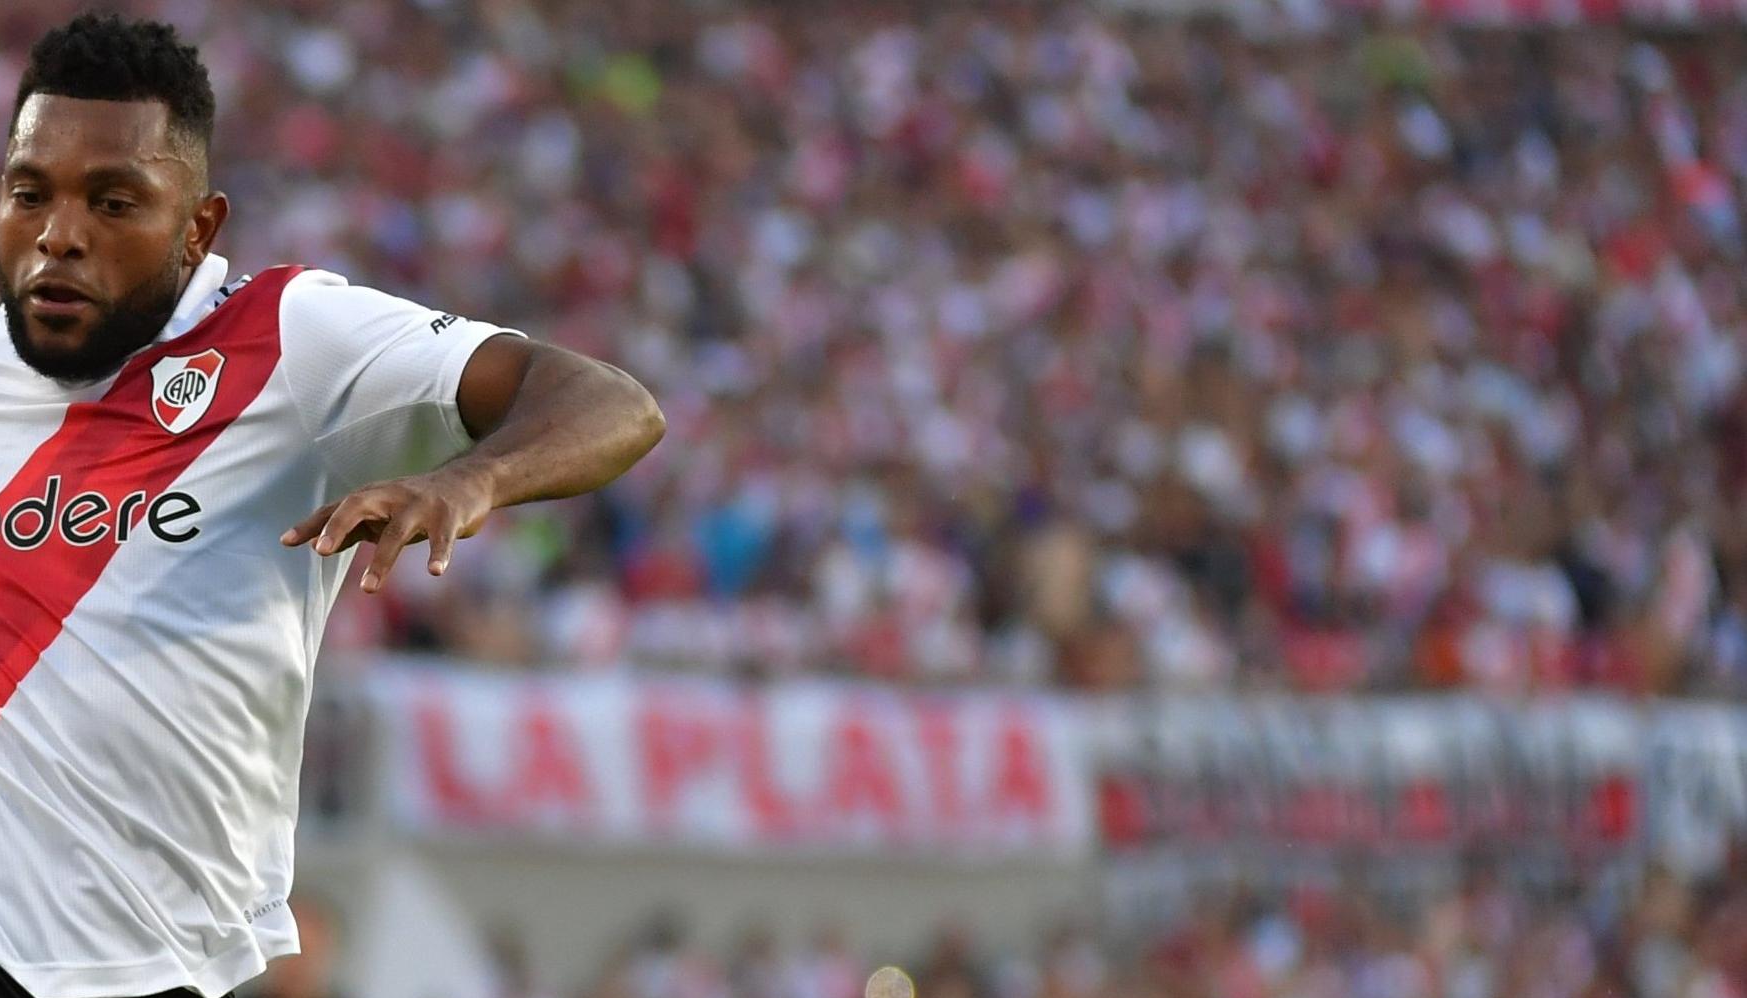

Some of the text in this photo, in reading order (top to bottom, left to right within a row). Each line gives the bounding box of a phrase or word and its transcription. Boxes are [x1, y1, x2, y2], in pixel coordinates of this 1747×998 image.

[164, 370, 207, 405] CARP
[411, 692, 593, 832] LA
[634, 692, 1054, 846] PLATA
